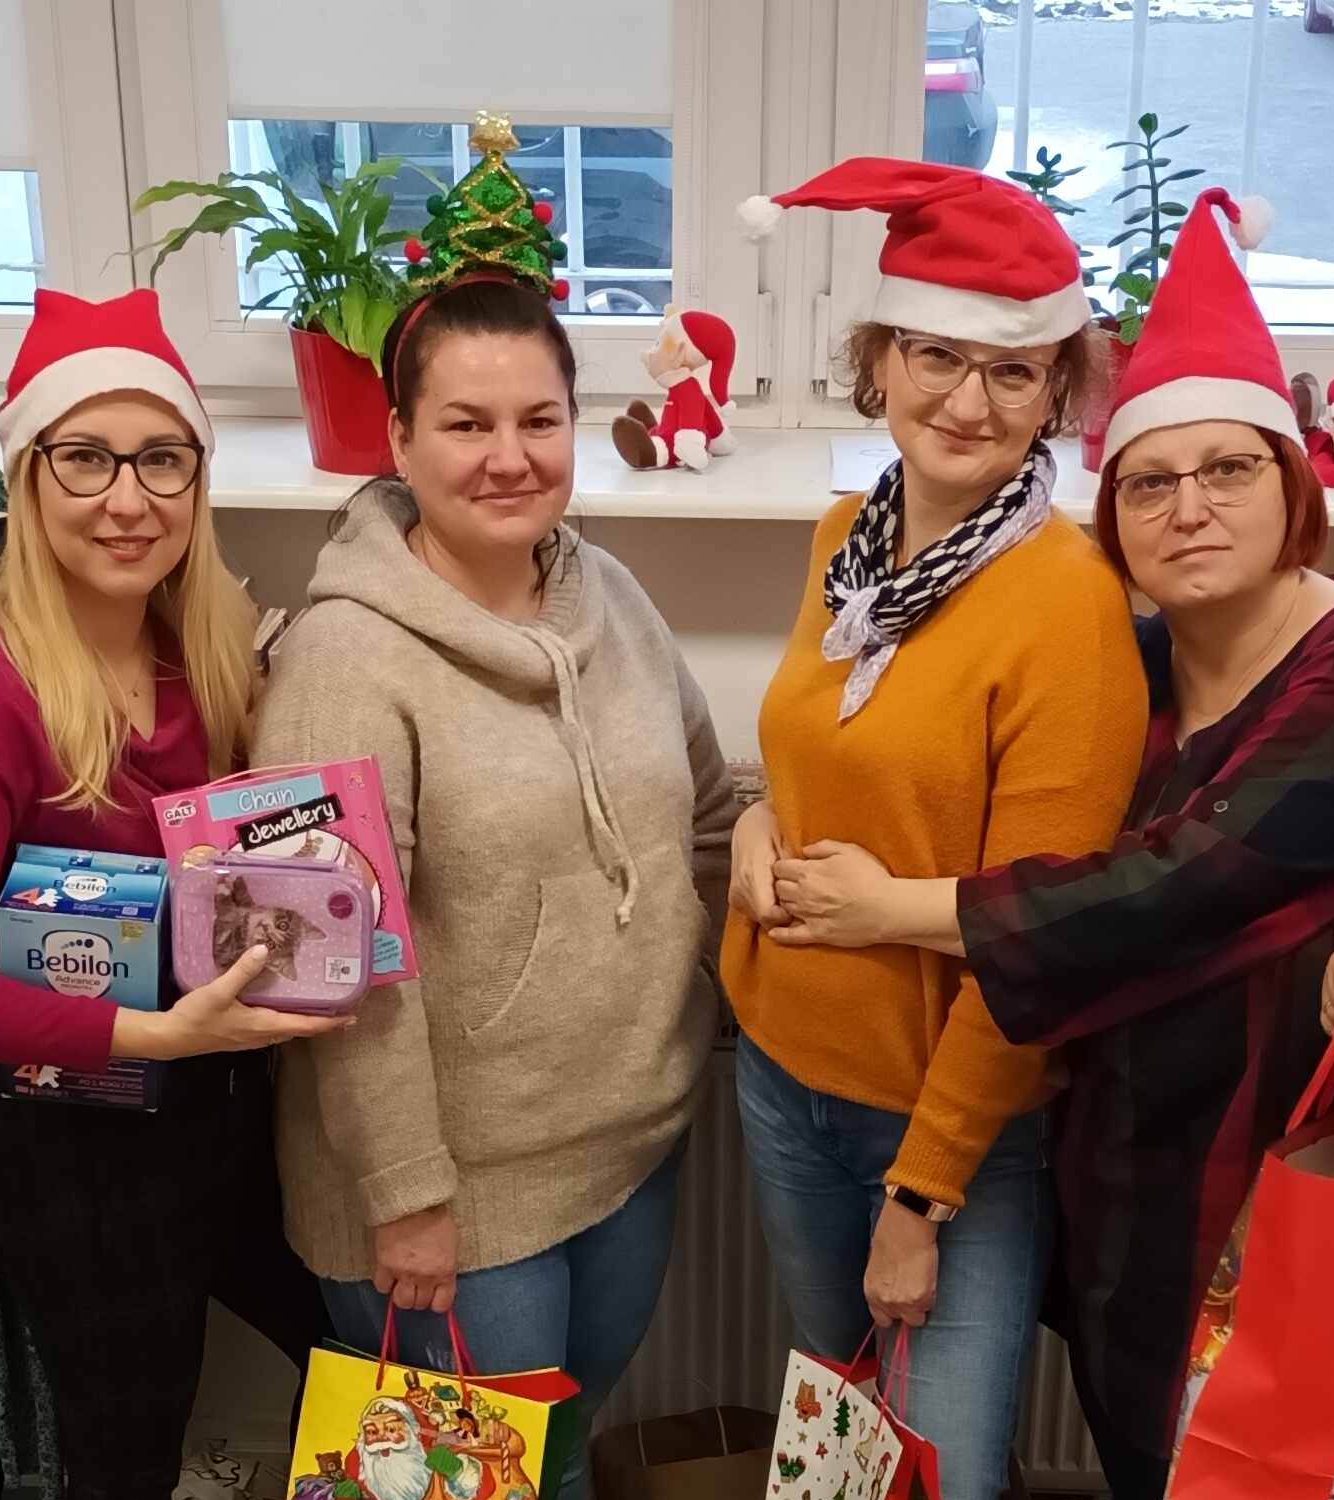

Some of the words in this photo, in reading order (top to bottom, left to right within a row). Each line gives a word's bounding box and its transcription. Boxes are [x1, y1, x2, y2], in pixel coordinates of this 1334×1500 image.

[238, 786, 295, 812] Chain
[164, 804, 194, 821] GALT
[247, 801, 336, 844] Jewellery
[12, 888, 41, 904] 4
[54, 879, 117, 894] Bebilon
[27, 949, 129, 979] Bebilon
[56, 975, 101, 986] Advance
[13, 1064, 40, 1085] 4
